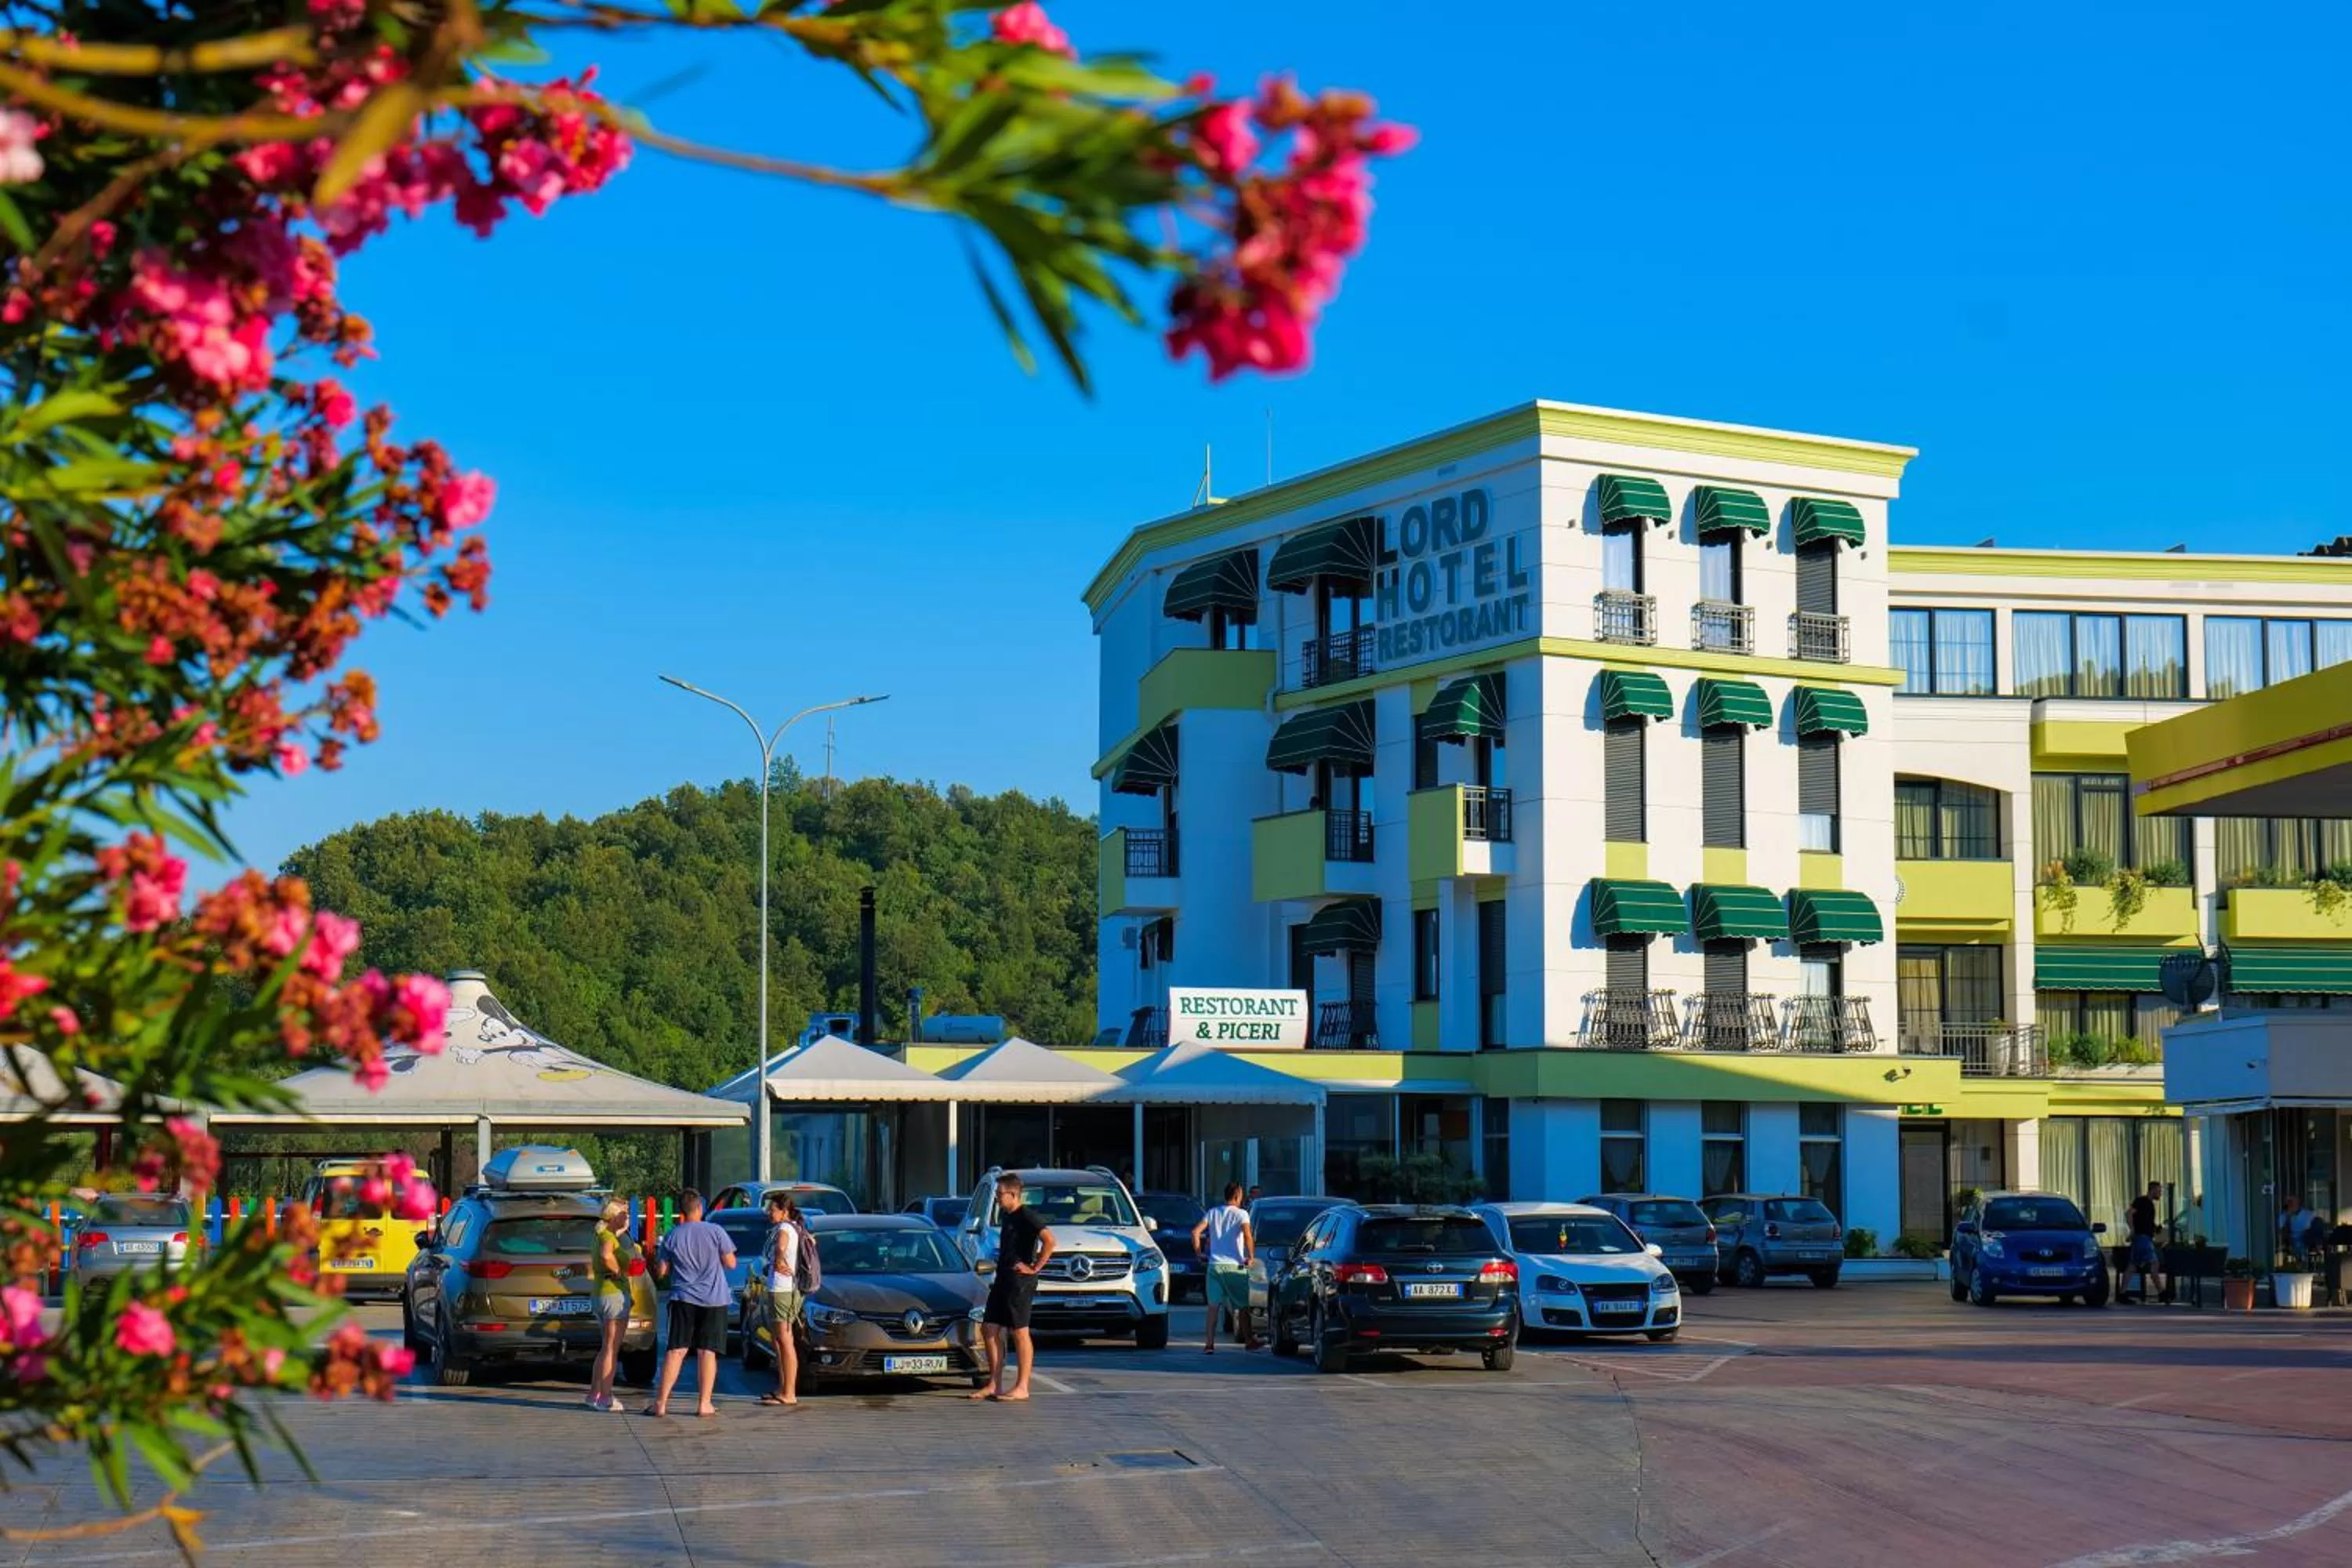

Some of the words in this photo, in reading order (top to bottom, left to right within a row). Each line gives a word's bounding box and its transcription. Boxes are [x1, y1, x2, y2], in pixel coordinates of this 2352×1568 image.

[1376, 488, 1489, 567] LORD
[1376, 535, 1528, 622] HOTEL
[1377, 593, 1529, 662] RESTORANT
[1179, 996, 1298, 1016] RESTORANT
[1196, 1022, 1212, 1040] &
[1217, 1022, 1281, 1040] PICERI
